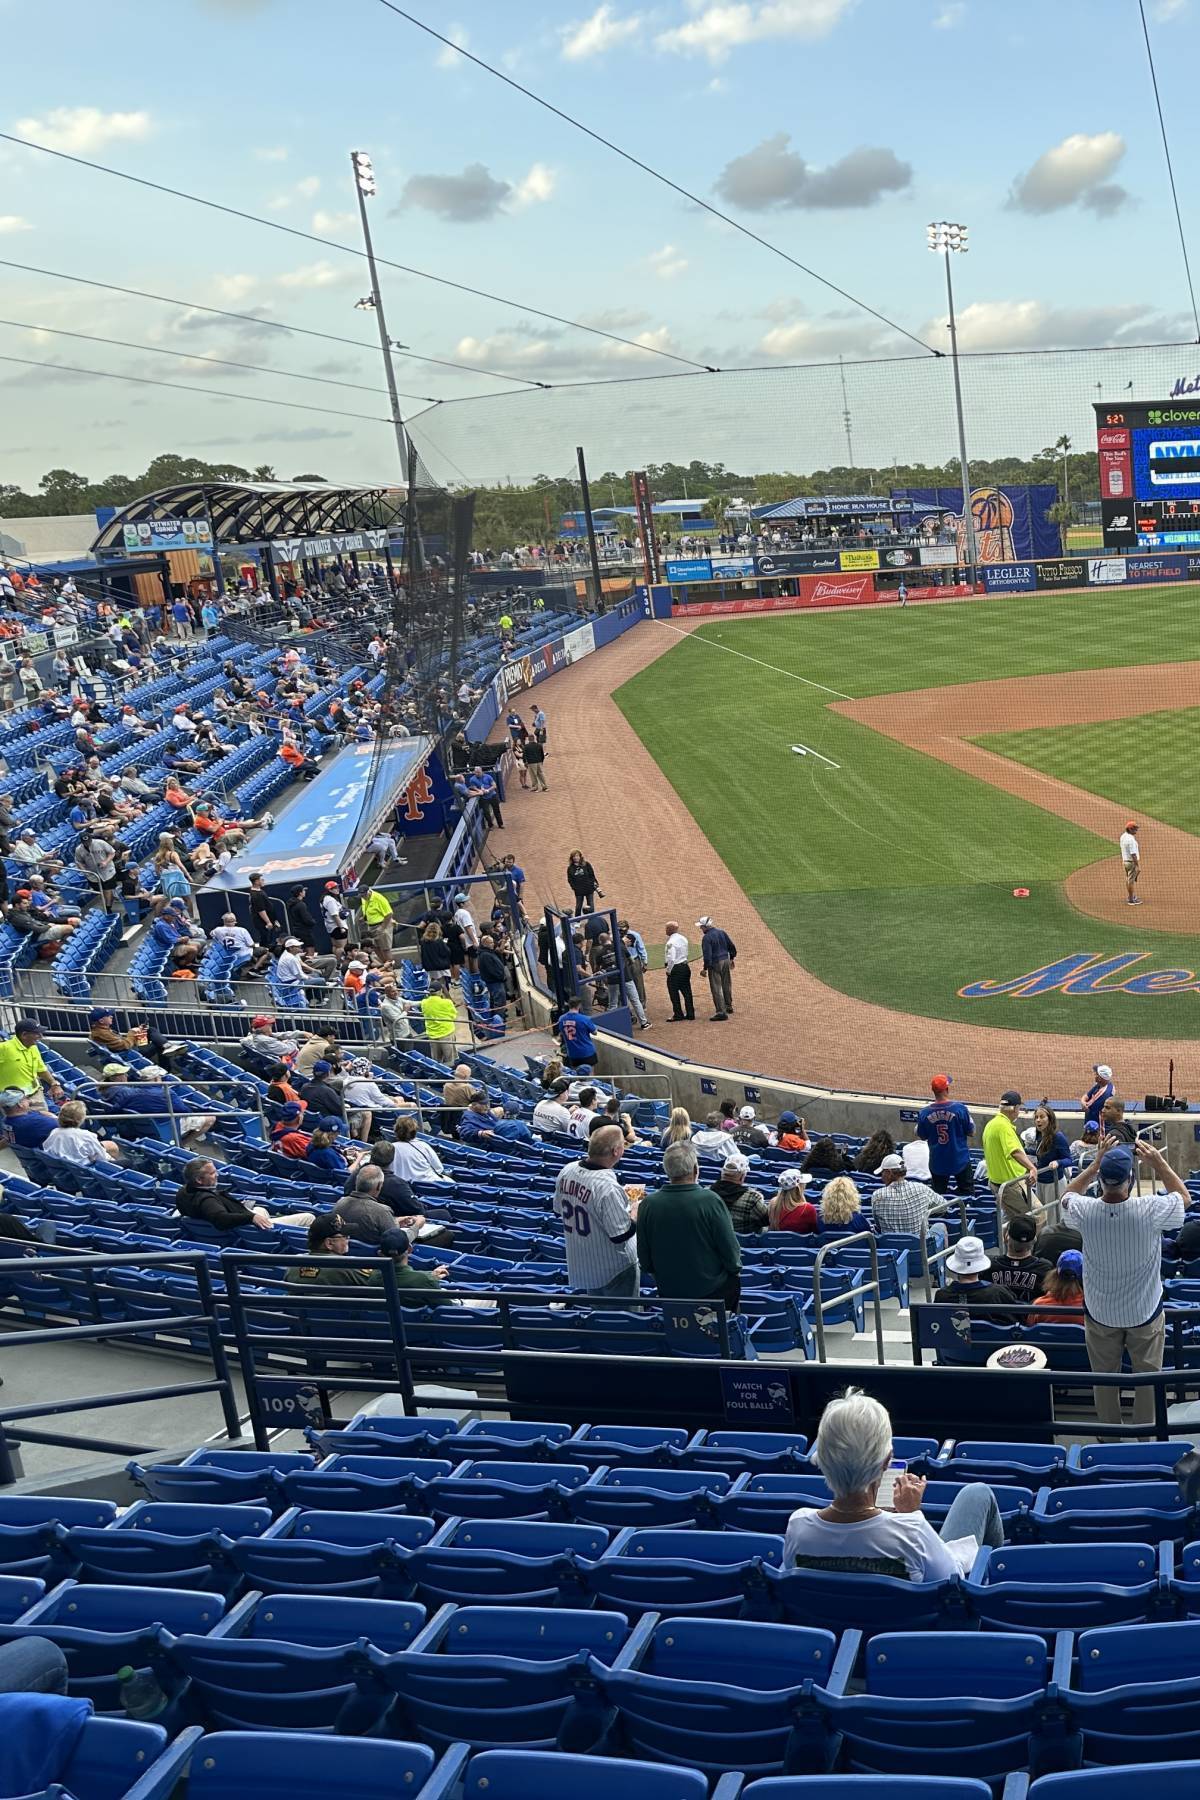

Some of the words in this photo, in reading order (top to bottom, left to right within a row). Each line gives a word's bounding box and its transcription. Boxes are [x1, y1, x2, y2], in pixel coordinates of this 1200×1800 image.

[1106, 414, 1124, 424] 5:27
[1170, 505, 1175, 514] 0
[1193, 504, 1198, 513] 0
[1128, 561, 1163, 570] NEAREST
[986, 567, 1031, 580] LEGLER
[1129, 570, 1140, 578] TO
[1142, 569, 1157, 577] THE
[1158, 567, 1181, 576] FIELD
[988, 578, 1030, 586] ORTHODONTICS
[816, 584, 862, 596] Budweiser
[936, 1124, 949, 1145] 5
[559, 1178, 592, 1205] ALONSO
[561, 1199, 591, 1238] 20
[992, 1270, 1038, 1290] PIAZZA
[671, 1317, 689, 1329] 10
[930, 1322, 940, 1334] 9
[732, 1382, 763, 1391] WATCH
[740, 1392, 758, 1400] FOR
[262, 1397, 296, 1413] 109
[726, 1401, 747, 1409] FOUL
[749, 1402, 774, 1410] BALLS
